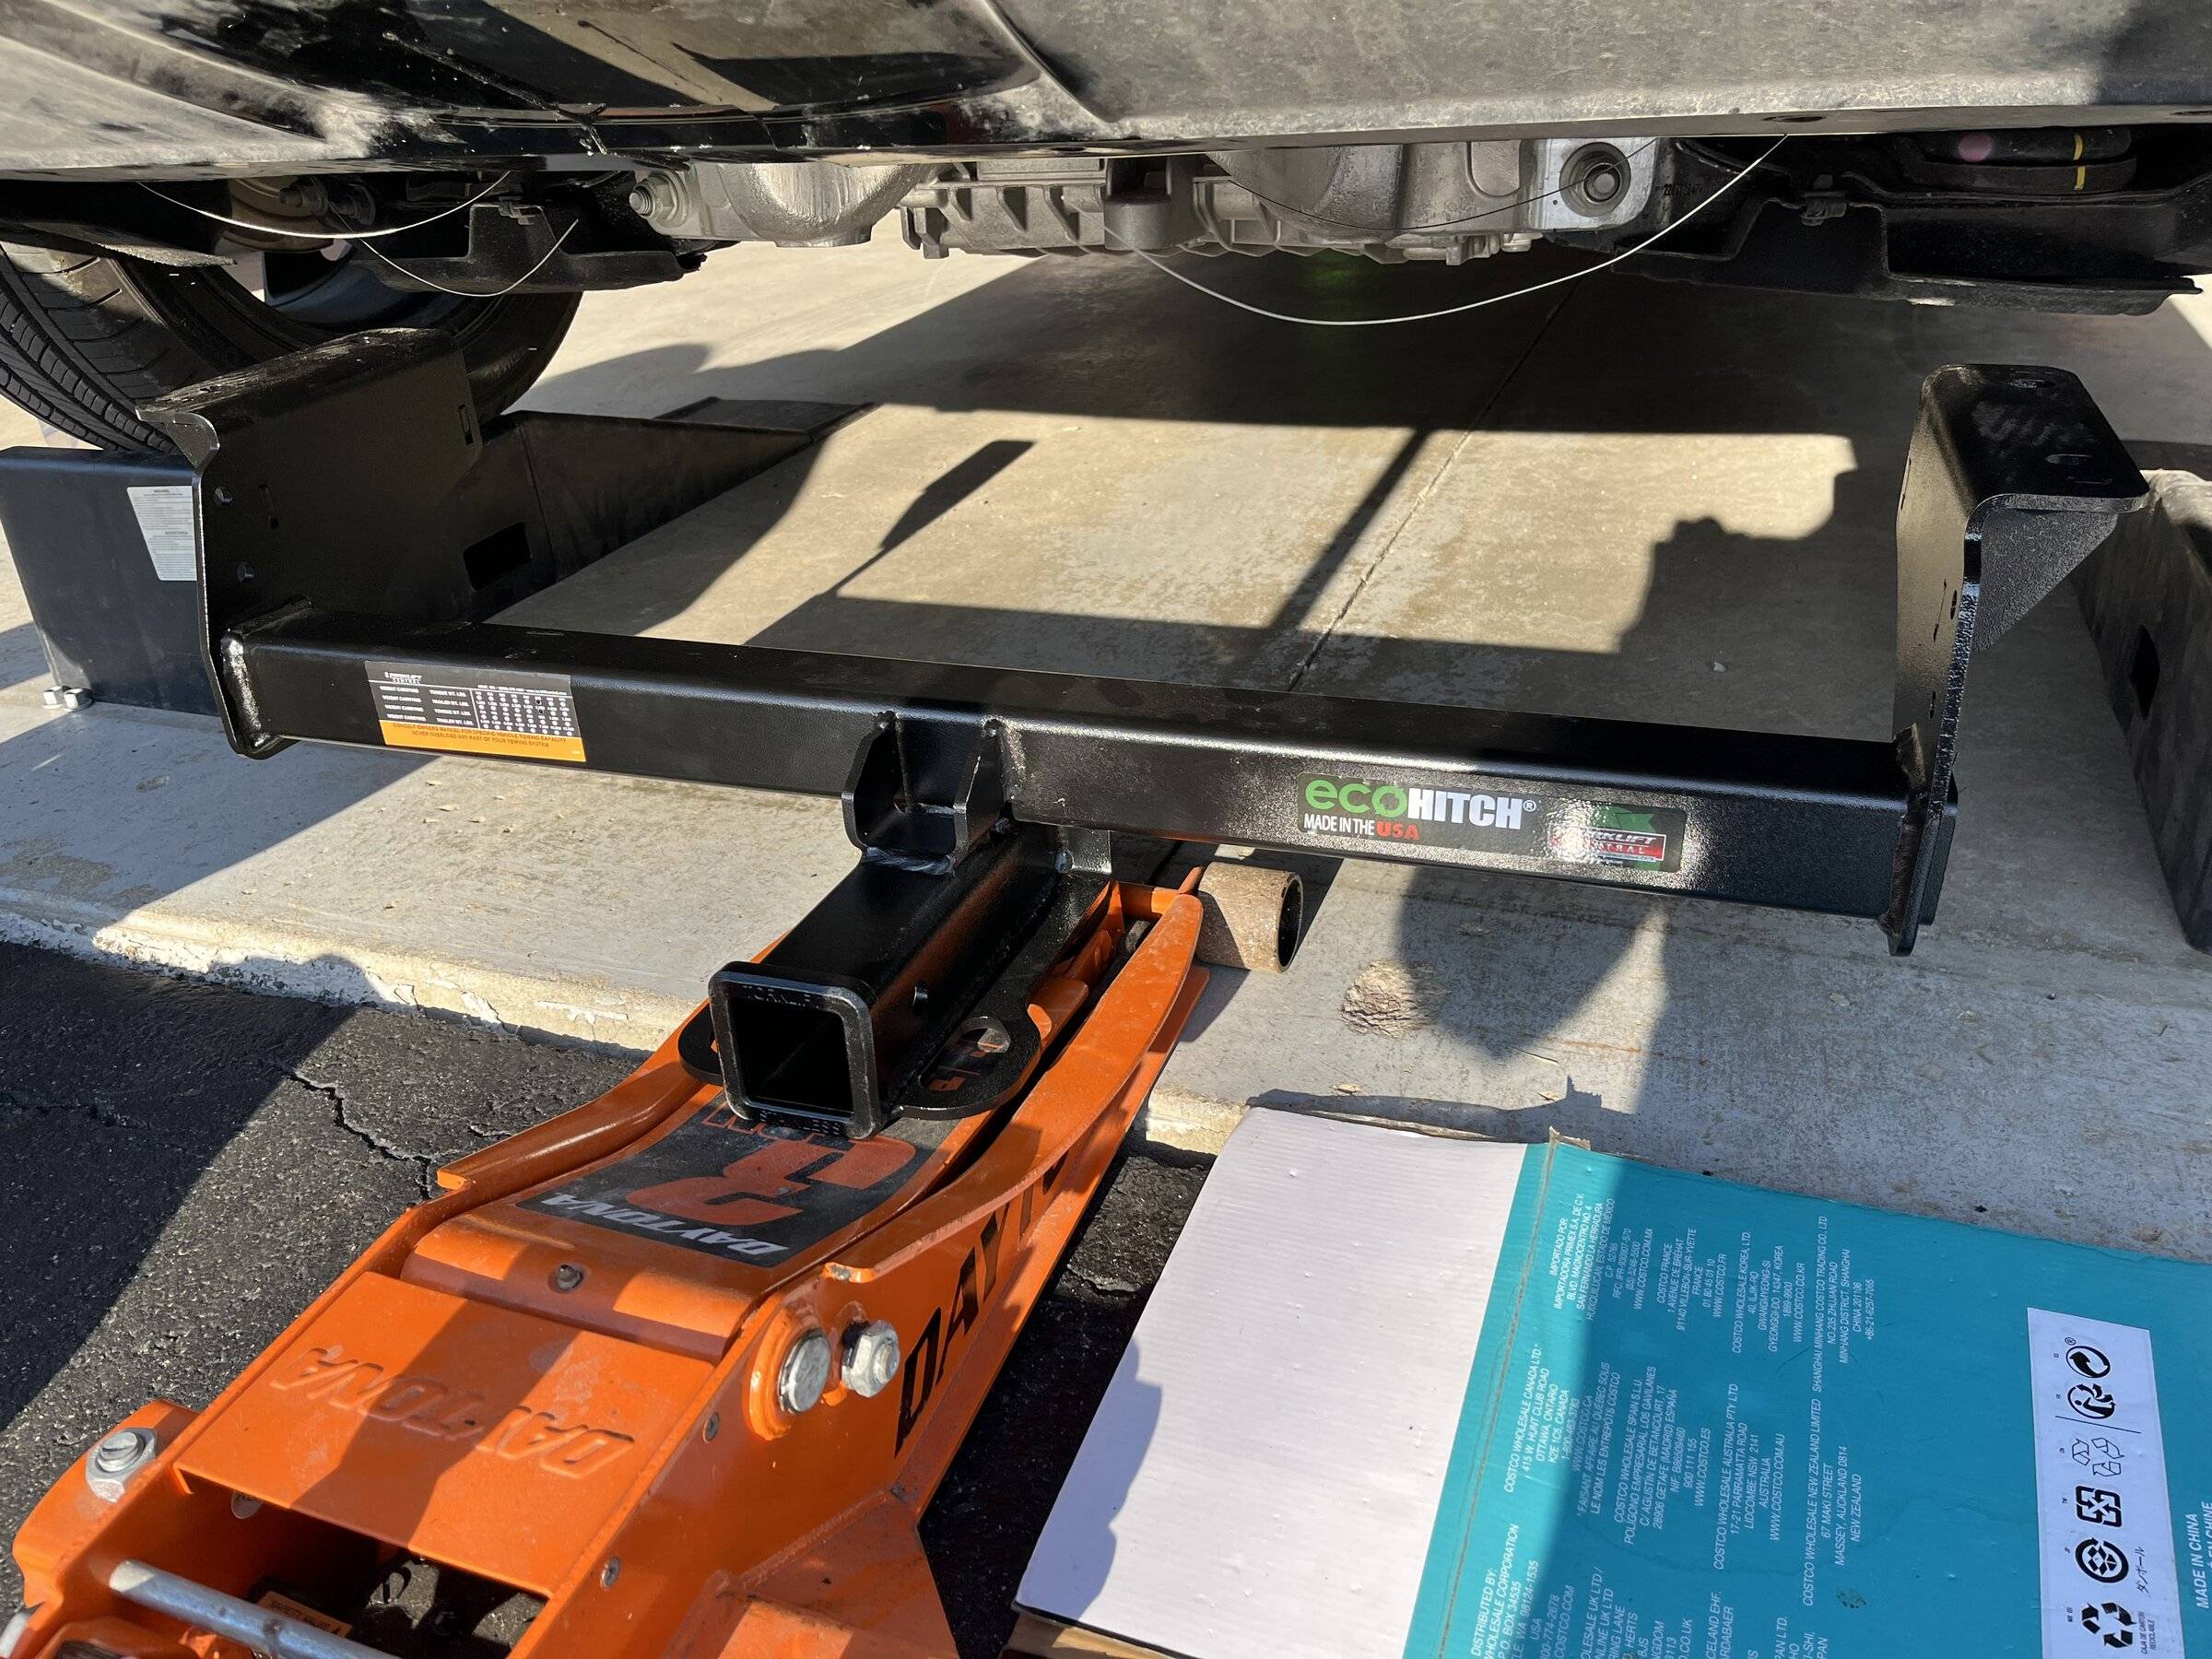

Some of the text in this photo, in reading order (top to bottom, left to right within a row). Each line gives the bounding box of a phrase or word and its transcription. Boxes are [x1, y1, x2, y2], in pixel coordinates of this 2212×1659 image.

[1304, 813, 1419, 840] MADE IN THE USA
[542, 1192, 789, 1254] DAYTONA
[1818, 1216, 1828, 1230] LTD
[1549, 1234, 1565, 1276] IMPORTADO
[1564, 1231, 1576, 1256] PRIMEX
[1817, 1246, 1827, 1278] TRADING
[1657, 1242, 1672, 1304] COSTCO FRANCE
[1679, 1228, 1696, 1308] VILLEBON-SUR-YVETTE
[1692, 1265, 1703, 1296] FRANCE
[1702, 1258, 1715, 1308] 01 80 45 01 10
[1829, 1261, 1838, 1284] ROAD
[1841, 1248, 1850, 1288] SHANGHAI
[1735, 1276, 1747, 1320] WHOLESALE
[1759, 1260, 1771, 1331] GWANGMYEONG-SI
[1816, 1279, 1825, 1312] COSTCO
[1829, 1285, 1837, 1316] ZHUJIAN
[1733, 1321, 1744, 1354] COSTCO
[1815, 1312, 1824, 1349] MINHANG
[1840, 1326, 1849, 1364] MINHANG
[1523, 1365, 1538, 1400] CANADA
[1535, 1368, 1548, 1392] ROAD
[1606, 1371, 1620, 1407] COSTCO
[1641, 1365, 1656, 1411] GAVILANES
[1655, 1385, 1665, 1395] 17
[1813, 1350, 1823, 1394] SHANGHAI
[269, 1347, 636, 1479] DAYTONA
[1532, 1393, 1545, 1417] CLUB
[1543, 1383, 1559, 1422] ONTARIO
[1555, 1389, 1569, 1425] CANADA
[1627, 1401, 1640, 1427] SPAIN
[1639, 1412, 1651, 1430] LOS
[1512, 1401, 1531, 1453] WHOLESALE
[1527, 1418, 1540, 1442] HUNT
[1660, 1424, 1674, 1464] (MADRID)
[1505, 1453, 1522, 1493] COSTCO
[1522, 1456, 1534, 1473] 415
[1596, 1459, 1607, 1477] LES
[1620, 1428, 1636, 1481] WHOLESALE
[1631, 1431, 1648, 1492] EMPRESARIAL
[1837, 1445, 1847, 1467] 0814
[1593, 1478, 1605, 1501] NOM
[1656, 1465, 1669, 1500] GETAFE
[1714, 1382, 1738, 1571] COSTCO WHOLESALE AUSTRALIA PTY LTD
[1731, 1422, 1747, 1535] 17-21 PARRAMATTA ROAD
[1745, 1433, 1759, 1529] LIDCOMBE NSW 2141
[1759, 1457, 1771, 1509] AUSTRALIA
[1836, 1468, 1847, 1521] AUCKLAND
[1591, 1503, 1601, 1515] LE
[1615, 1482, 1629, 1524] COSTCO
[1804, 1398, 1821, 1606] COSTCO WHOLESALE NEW ZEALAND LIMITED
[1821, 1462, 1833, 1539] 67 MAKI STREET
[1851, 1473, 1861, 1542] NEW ZEALAND
[1496, 1524, 1519, 1598] CORPORATION
[2134, 1546, 2148, 1594] ダンボール
[2185, 1512, 2210, 1609] MADE IN CHINA
[1507, 1580, 1522, 1612] 34535
[1516, 1559, 1538, 1640] WA 98124-1535
[1588, 1574, 1602, 1612] UK LTD
[1599, 1588, 1613, 1627] UK LTD
[1471, 1587, 1493, 1657] DISTRIBUTED
[1502, 1613, 1515, 1637] BOX
[1530, 1618, 1542, 1641] USA
